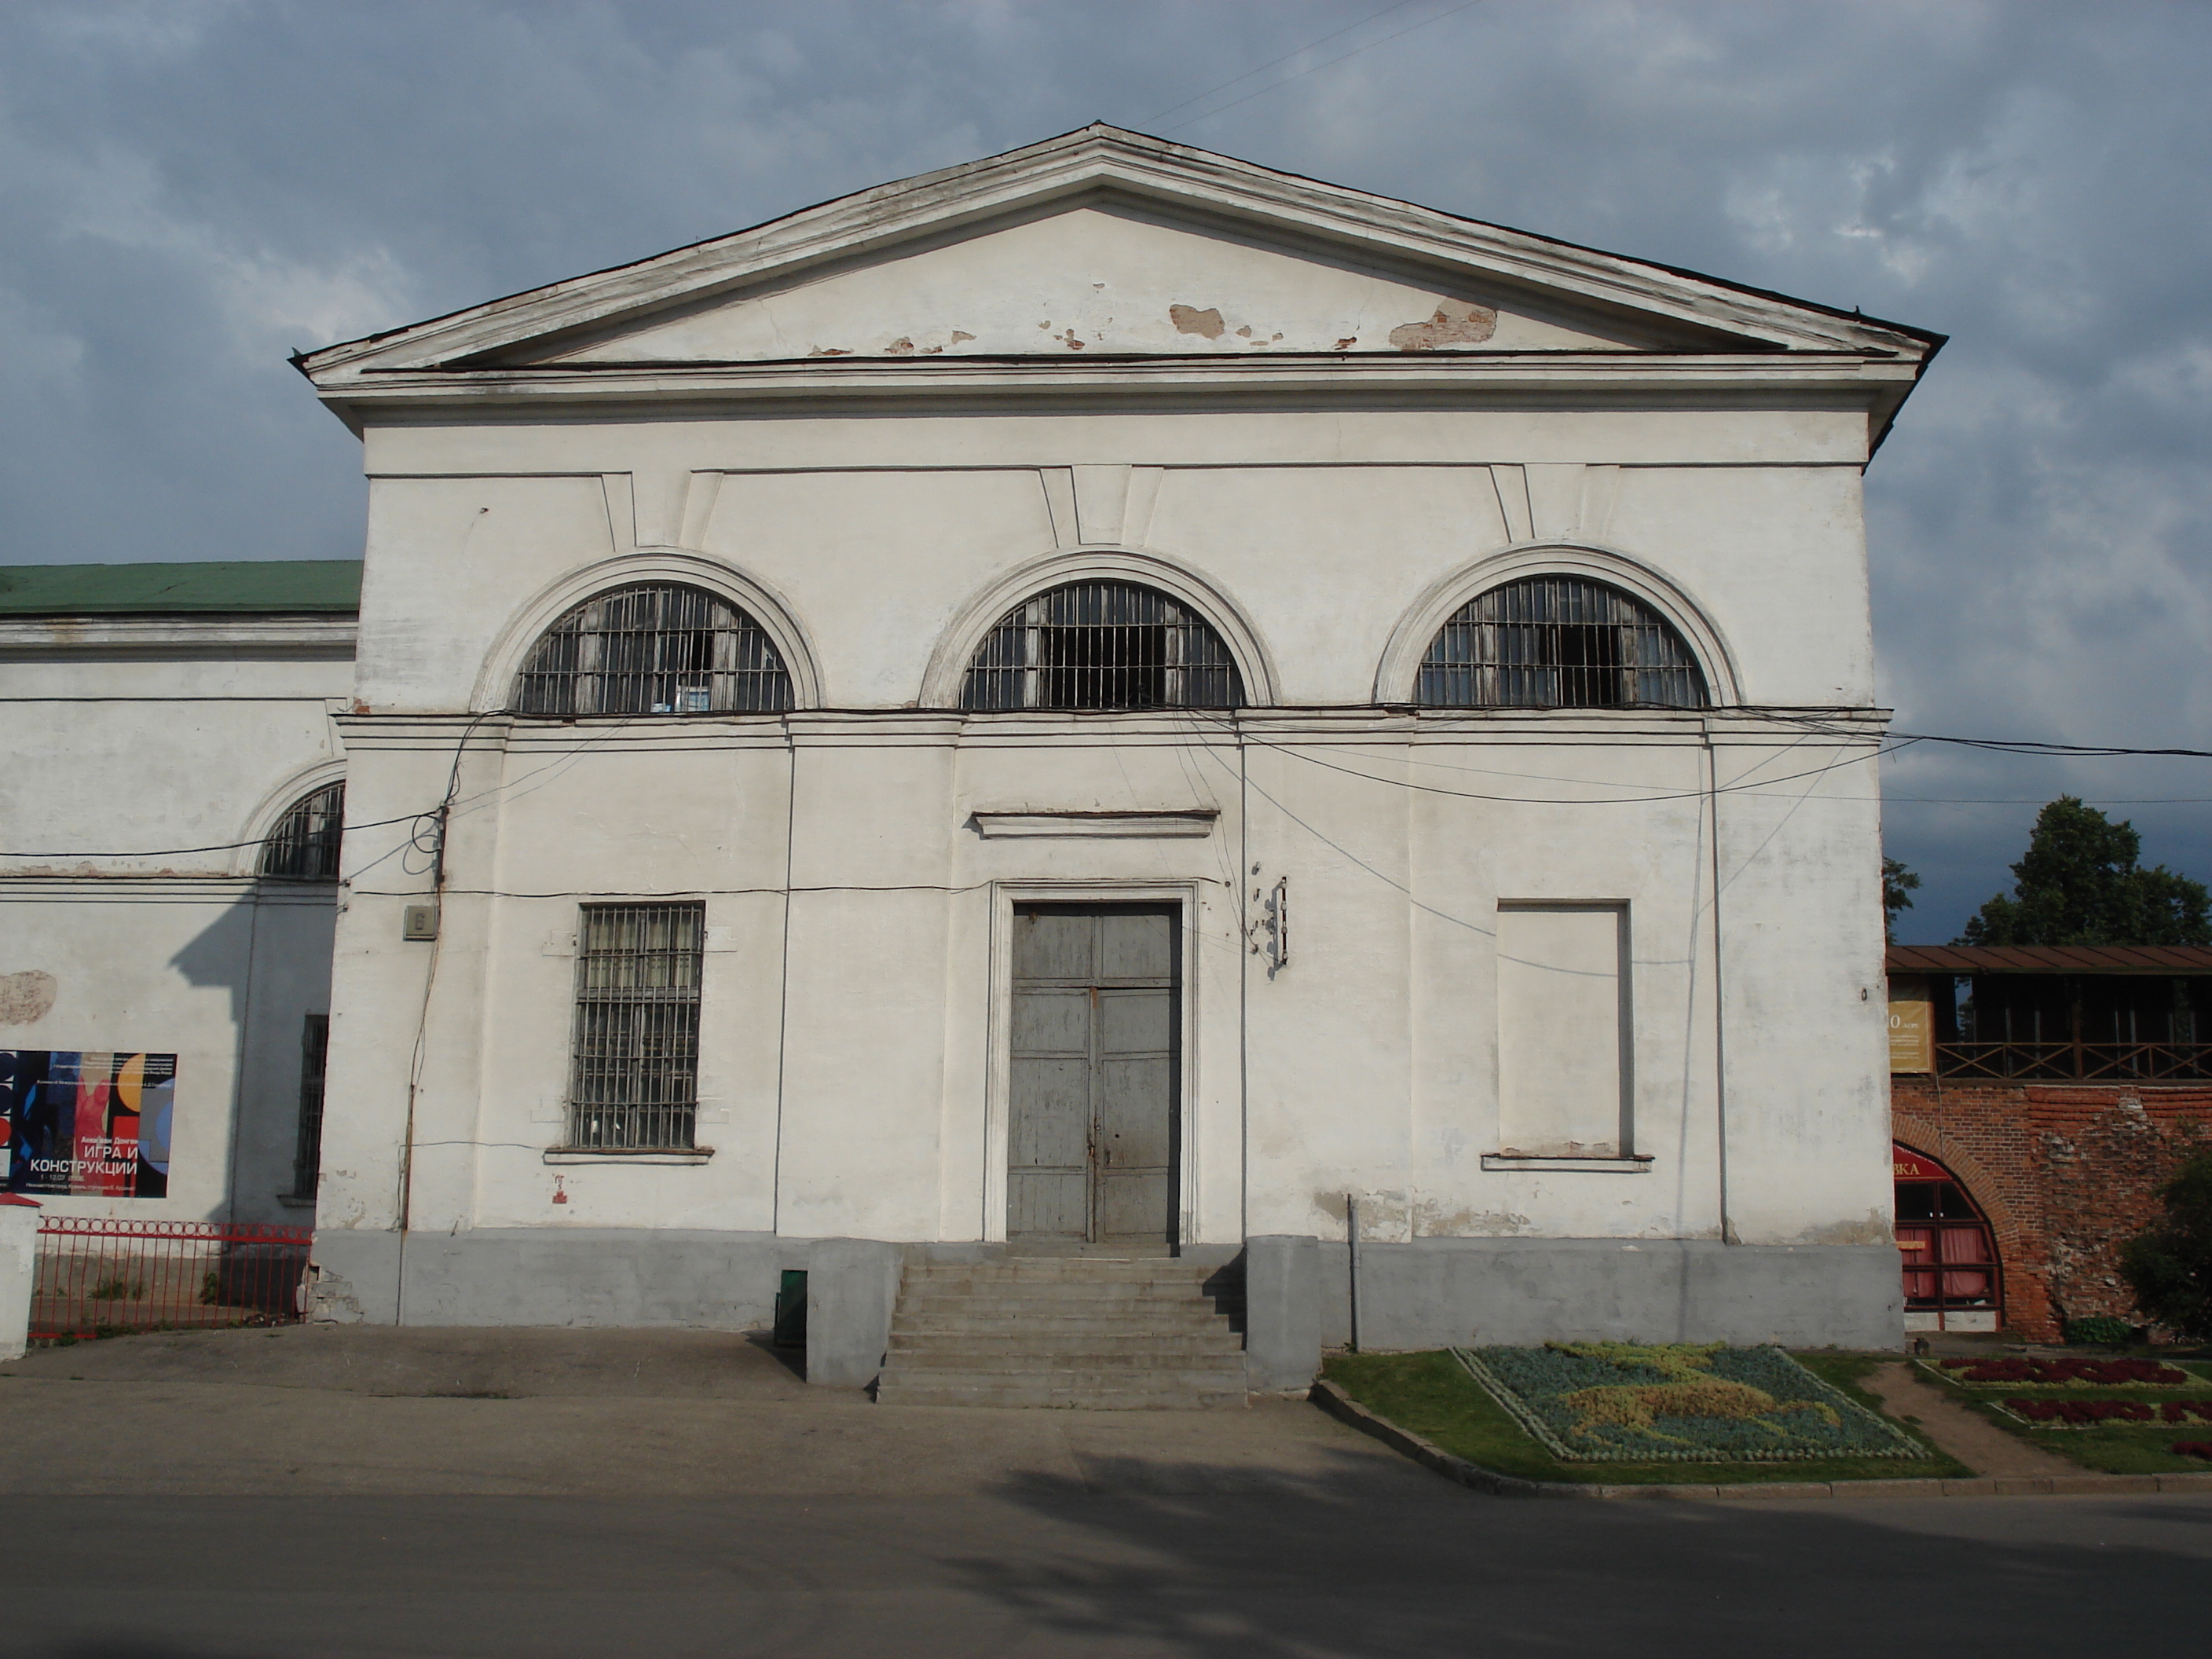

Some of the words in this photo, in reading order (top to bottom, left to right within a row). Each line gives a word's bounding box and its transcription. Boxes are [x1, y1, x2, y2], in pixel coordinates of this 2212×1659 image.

[84, 1145, 122, 1159] ИГРА
[127, 1146, 138, 1159] И
[30, 1159, 137, 1176] КОНСТРУКЦИИ
